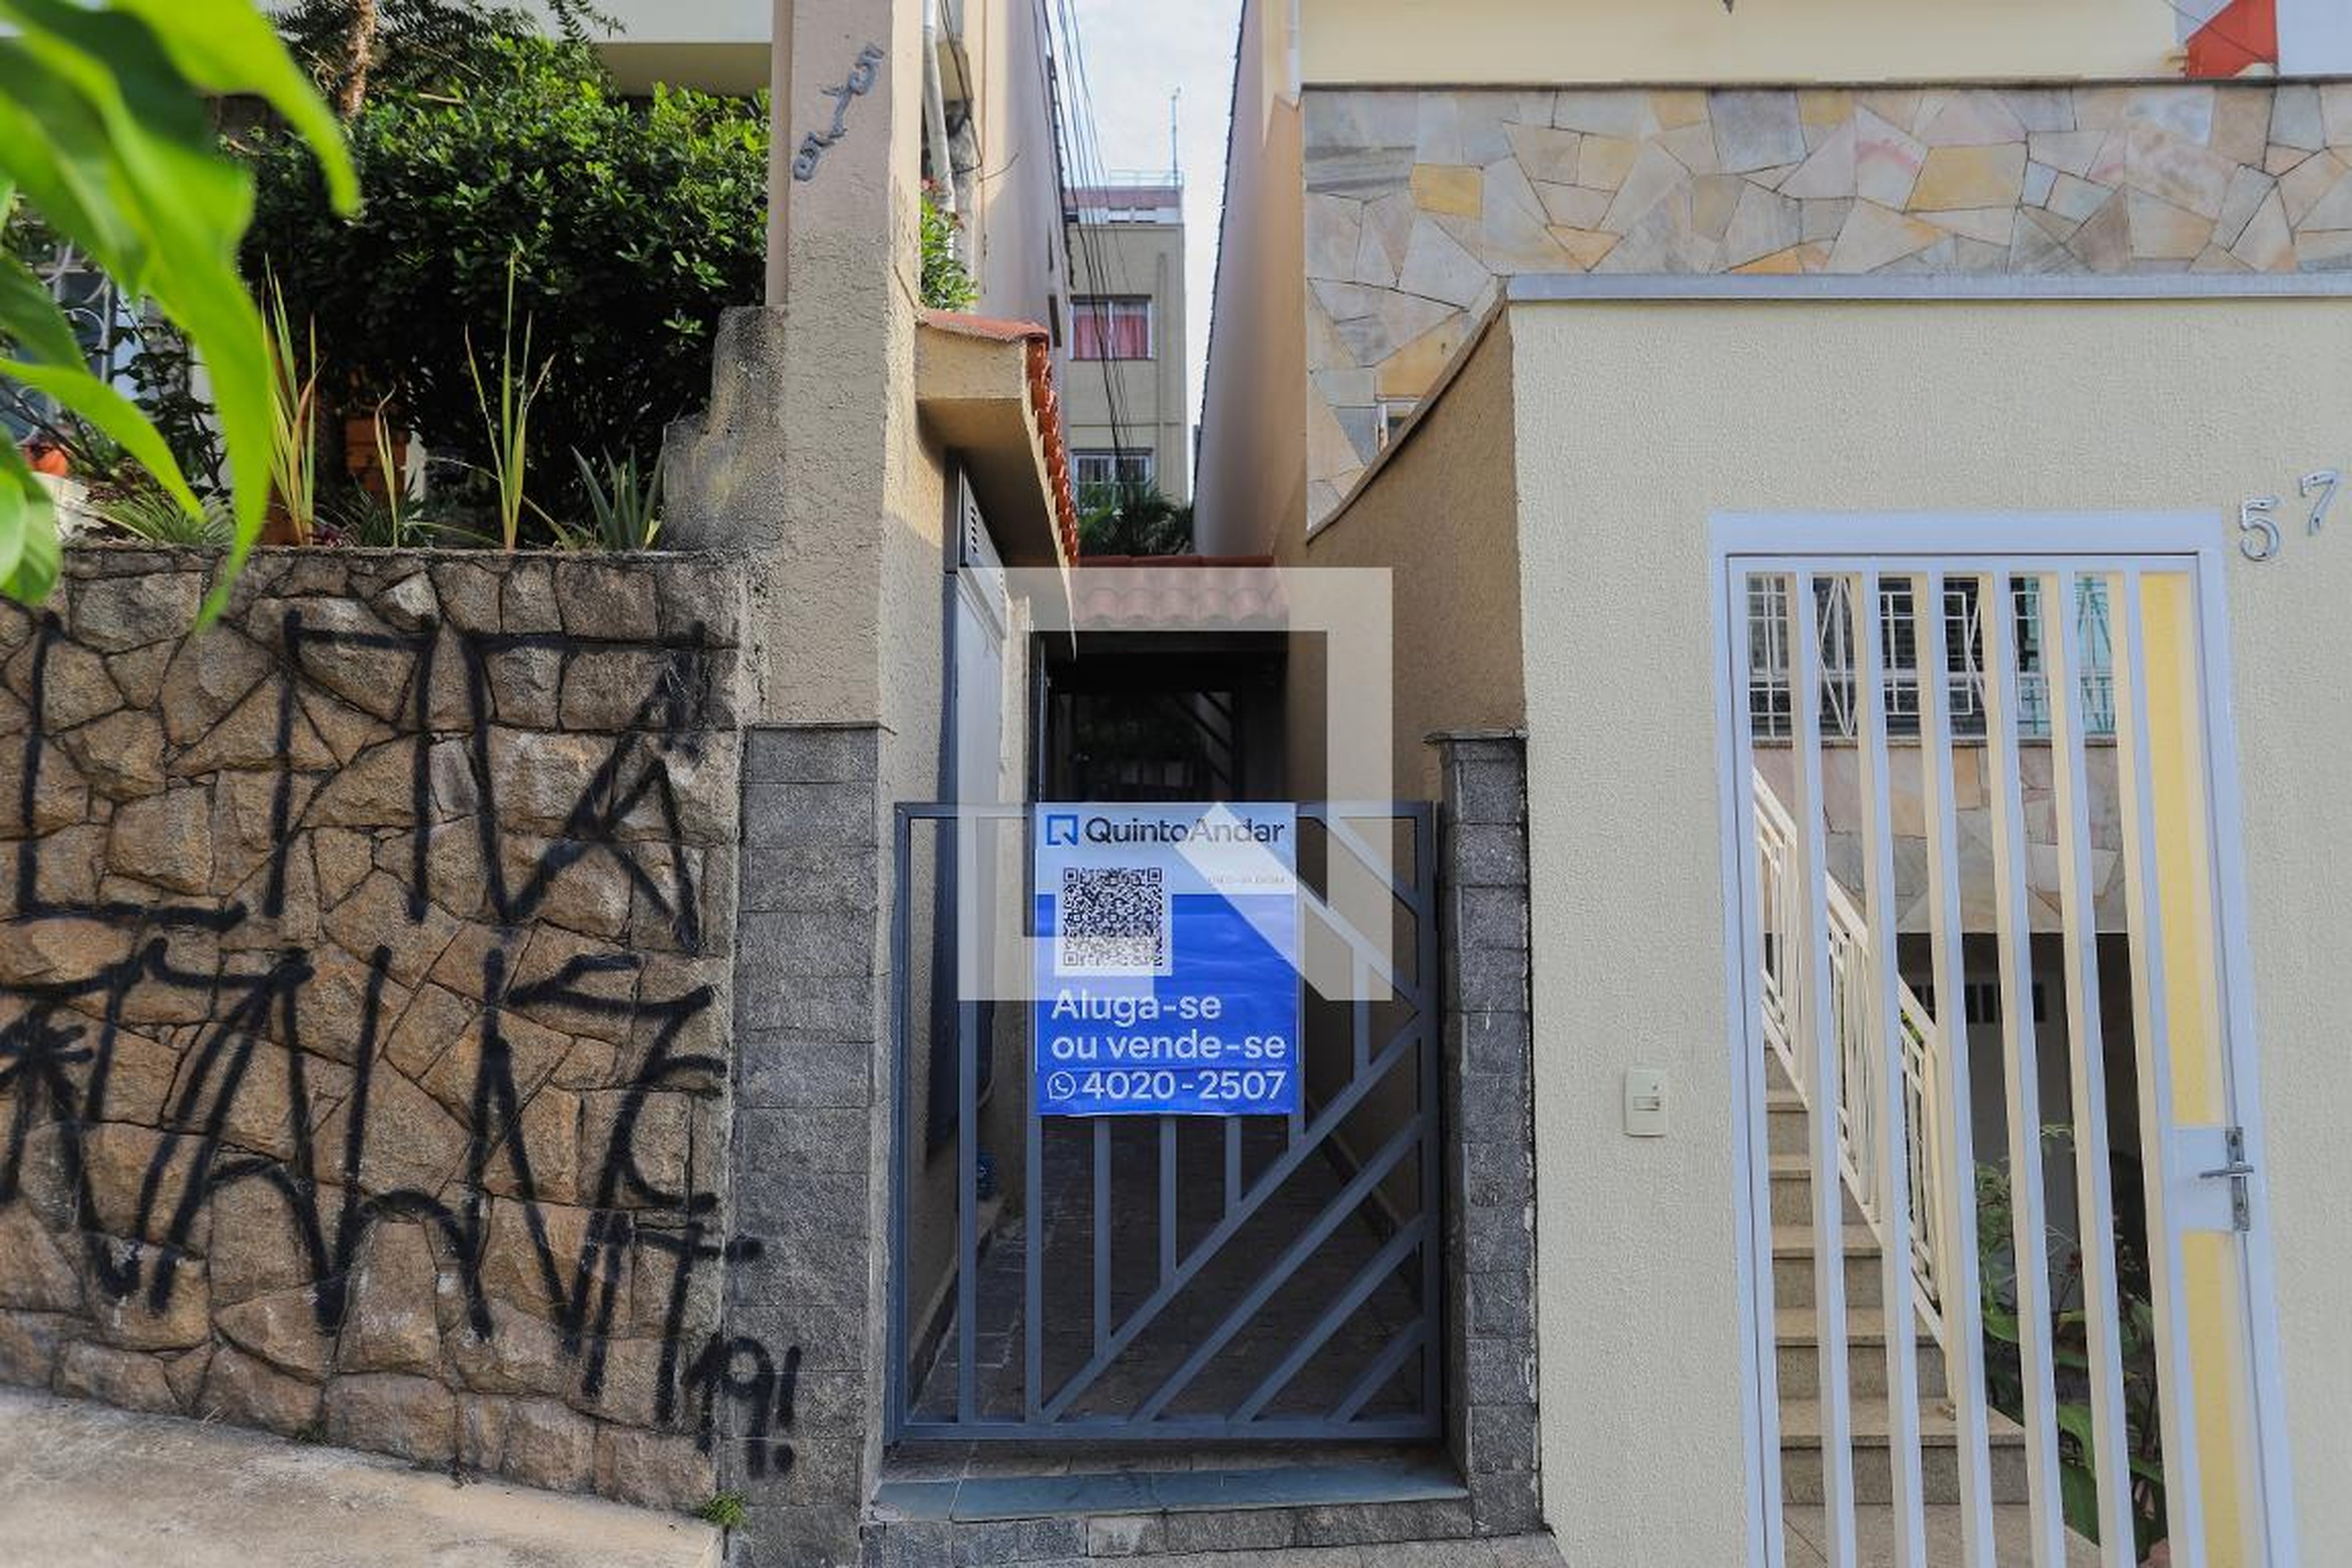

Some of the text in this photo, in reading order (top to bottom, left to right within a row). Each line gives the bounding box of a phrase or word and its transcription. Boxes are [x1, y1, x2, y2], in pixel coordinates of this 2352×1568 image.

[2239, 469, 2337, 562] 57
[1085, 816, 1285, 844] QuintoAndar
[1051, 988, 1222, 1027] Aluga-se
[1051, 1028, 1286, 1060] ou vende-se
